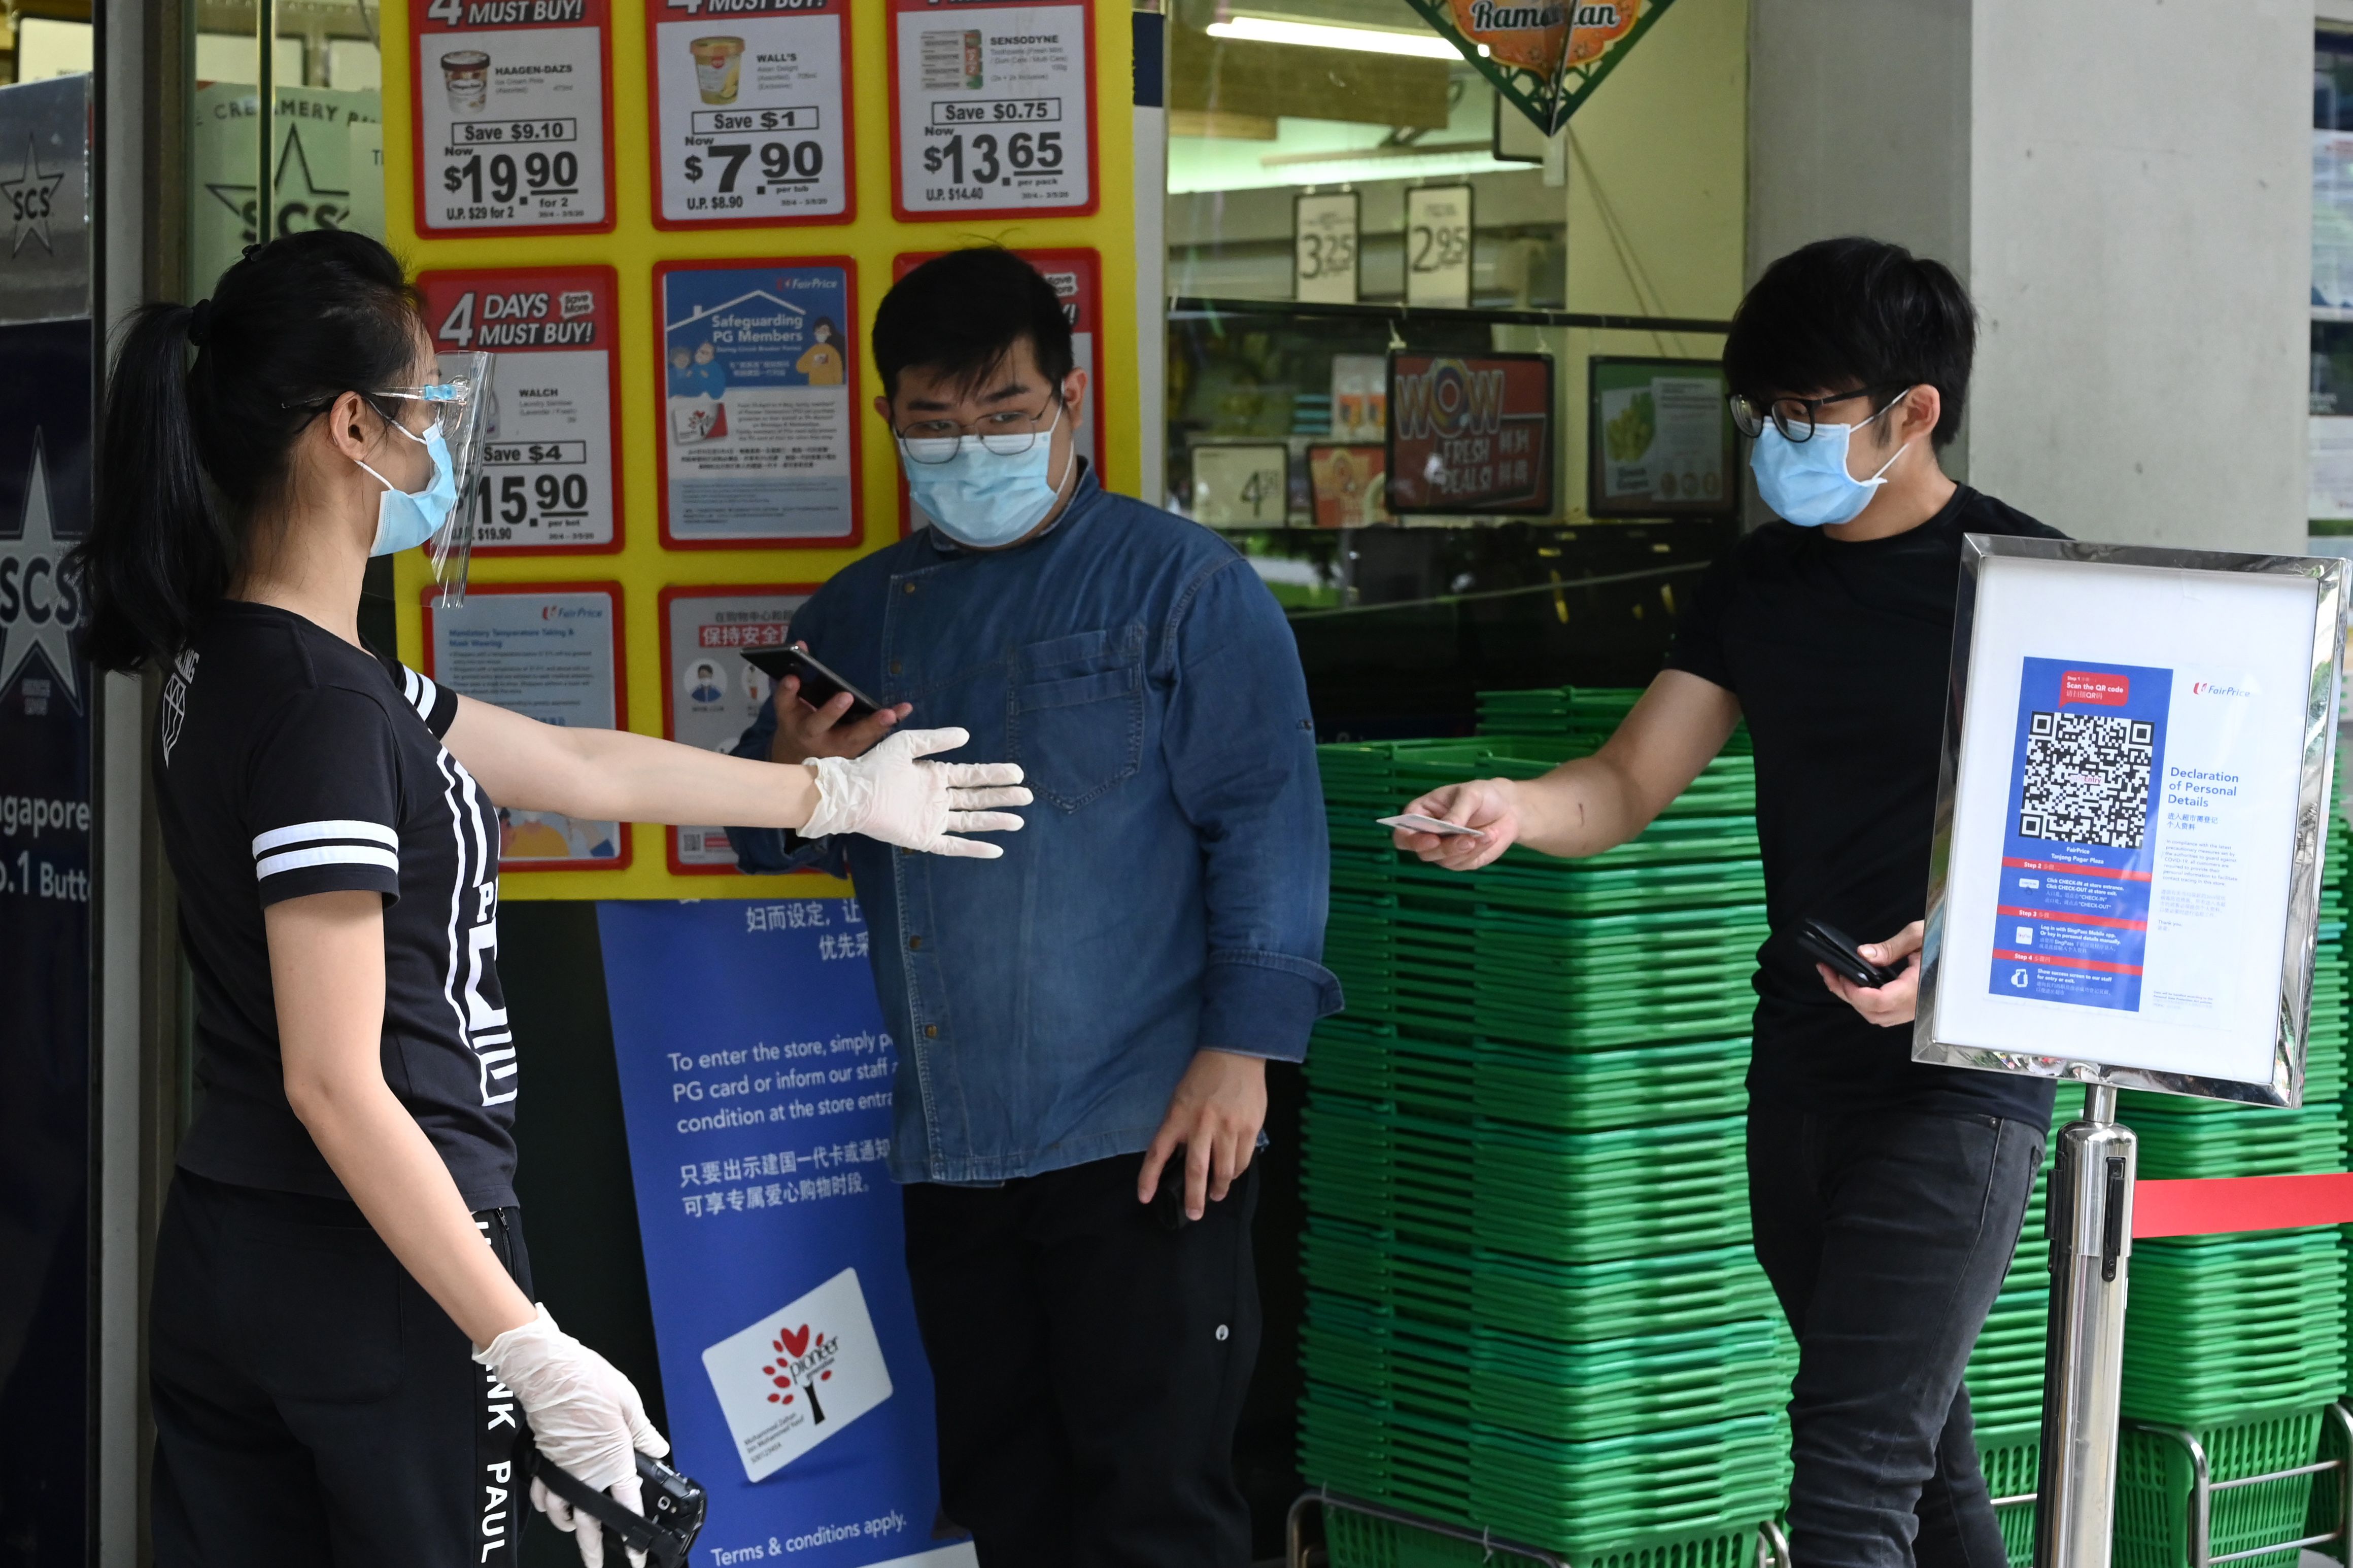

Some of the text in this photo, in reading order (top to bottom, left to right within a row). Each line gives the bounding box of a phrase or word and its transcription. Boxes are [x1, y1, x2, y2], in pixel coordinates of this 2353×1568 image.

[468, 0, 584, 24] MUST BUY!
[1473, 1, 1617, 29] Ramaan
[990, 35, 1059, 45] SENSODYNE
[757, 53, 797, 62] WALL'S
[214, 99, 338, 122] CREMERY
[945, 102, 1048, 122] Save $0.75
[714, 111, 796, 131] Save $1
[924, 126, 954, 136] Now
[464, 122, 564, 142] Save $9.10
[685, 136, 714, 147] Now
[445, 146, 473, 156] Now
[924, 131, 1063, 187] $13.65
[684, 140, 824, 195] $7.90
[444, 151, 578, 205] $19.90
[13, 187, 51, 221] SCS
[540, 197, 568, 207] for 2
[687, 195, 743, 211] U.P. $8.90
[926, 187, 983, 201] U.P. $14.40
[446, 206, 514, 220] U.P. $29 for 2
[792, 278, 838, 290] FairPrice
[438, 292, 550, 346] 4 DAYS
[711, 313, 804, 329] Safeguarding
[478, 321, 593, 346] MUST BUY!
[712, 330, 804, 343] PG Members
[519, 388, 558, 398] WALCH
[1394, 358, 1505, 440] WOW
[484, 444, 562, 464] Save $4
[478, 527, 512, 541] $19.90
[0, 555, 79, 628] SCS
[558, 607, 603, 618] FairPrice
[2208, 686, 2250, 696] FairPrice
[2171, 767, 2238, 782] Declaration
[2169, 781, 2236, 795] of Personal
[2168, 794, 2208, 807] Details
[0, 796, 90, 839] gapore
[2168, 813, 2218, 823] 进入超市需登记
[2168, 821, 2195, 830] 个人资料
[2052, 853, 2071, 861] Tanjong
[668, 1030, 894, 1072] To enter the store, simply p
[672, 1056, 888, 1103] PG card or inform our staff
[676, 1106, 765, 1134] condition
[769, 1105, 786, 1122] at
[789, 1098, 814, 1120] the
[817, 1096, 855, 1116] store
[680, 1137, 891, 1189] 只要出示建国一代卡或通知
[682, 1171, 870, 1218] 可享专属爱心购物时段。
[790, 1335, 839, 1385] pioneer
[481, 1365, 516, 1564] NK PAUL
[710, 1509, 907, 1567] Terms & conditions apply.
